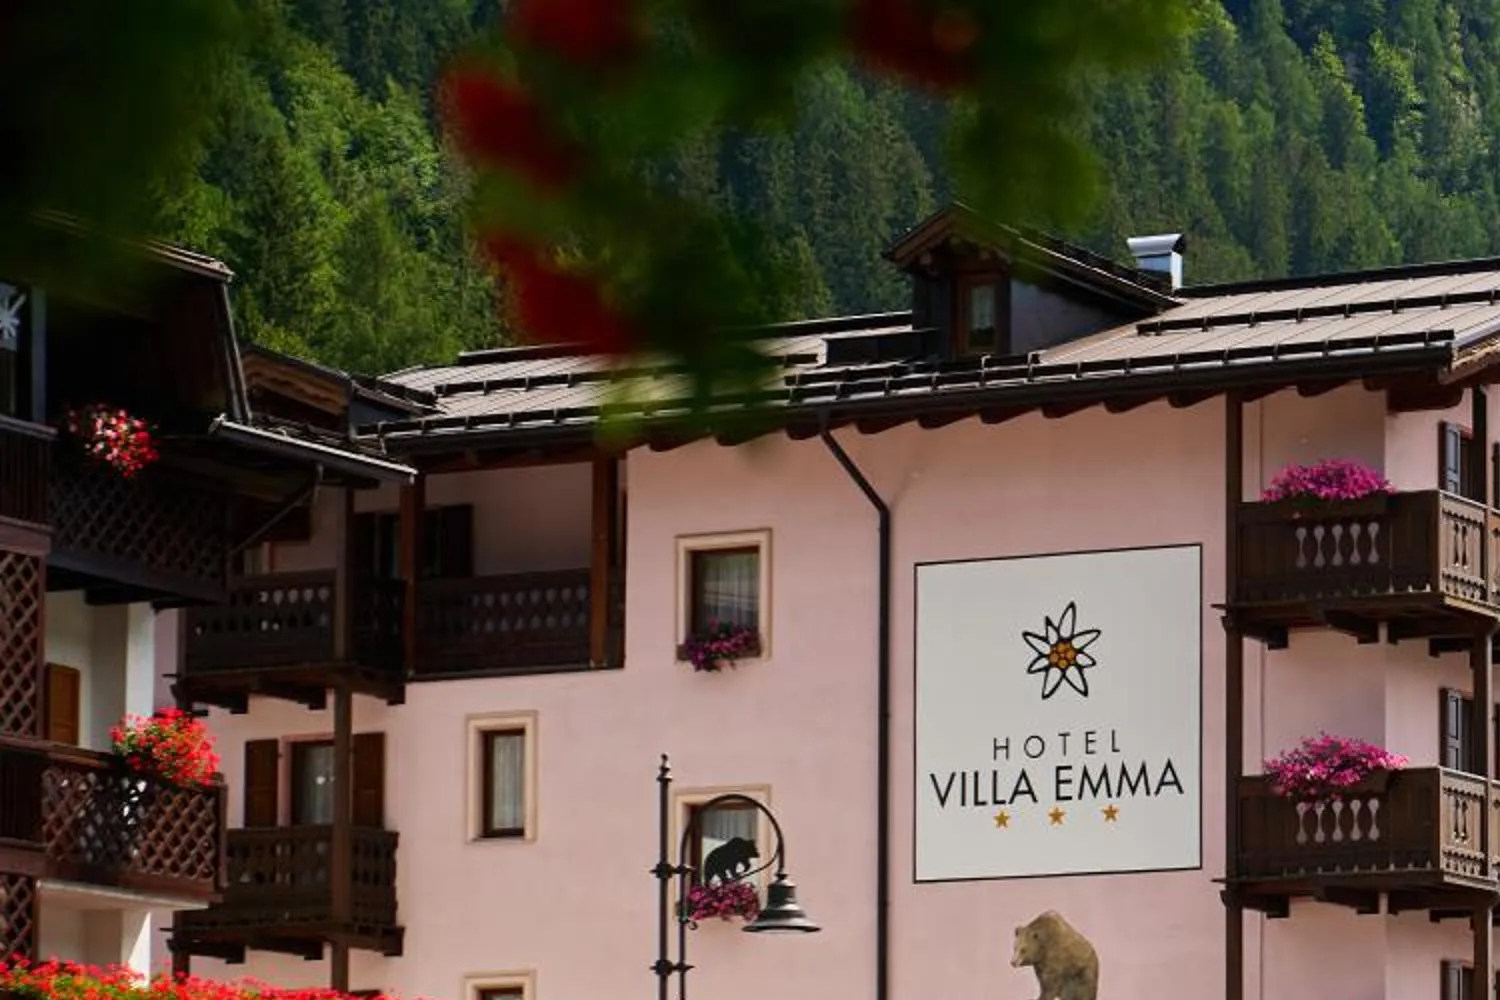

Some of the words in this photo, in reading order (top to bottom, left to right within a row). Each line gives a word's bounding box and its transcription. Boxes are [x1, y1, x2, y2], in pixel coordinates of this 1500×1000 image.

[993, 730, 1121, 761] HOTEL
[930, 768, 1038, 807] VILLA
[1055, 758, 1184, 802] EMMA
